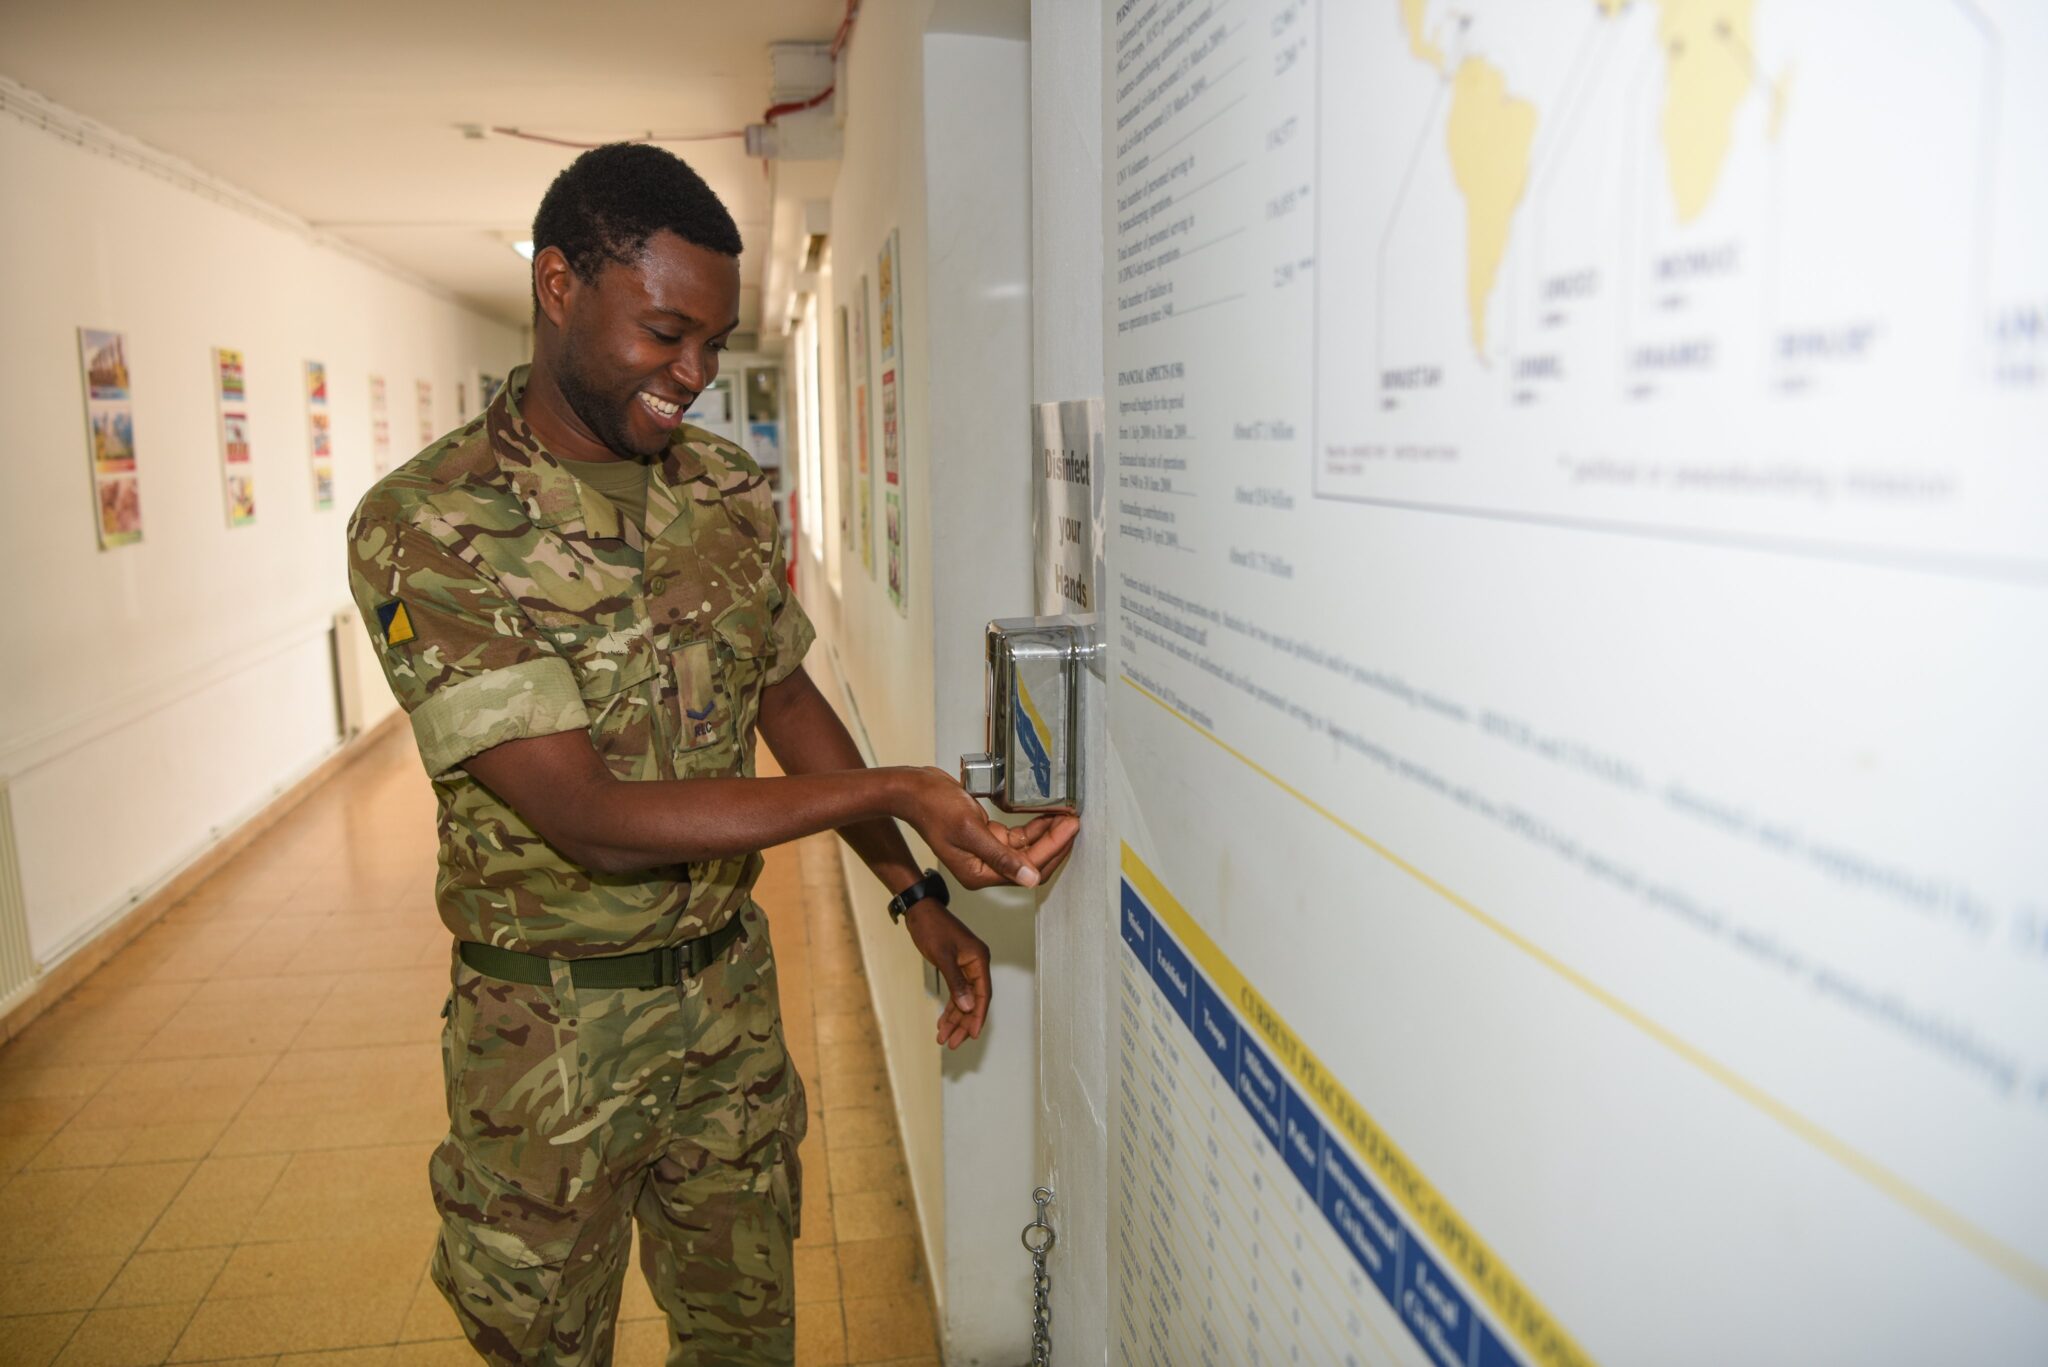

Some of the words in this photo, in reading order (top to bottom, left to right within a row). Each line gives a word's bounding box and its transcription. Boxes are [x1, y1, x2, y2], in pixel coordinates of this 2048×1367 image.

[1045, 448, 1090, 486] Disinfect
[1058, 515, 1081, 546] your
[1055, 563, 1088, 609] Hands
[1241, 986, 1297, 1065] CURRENT
